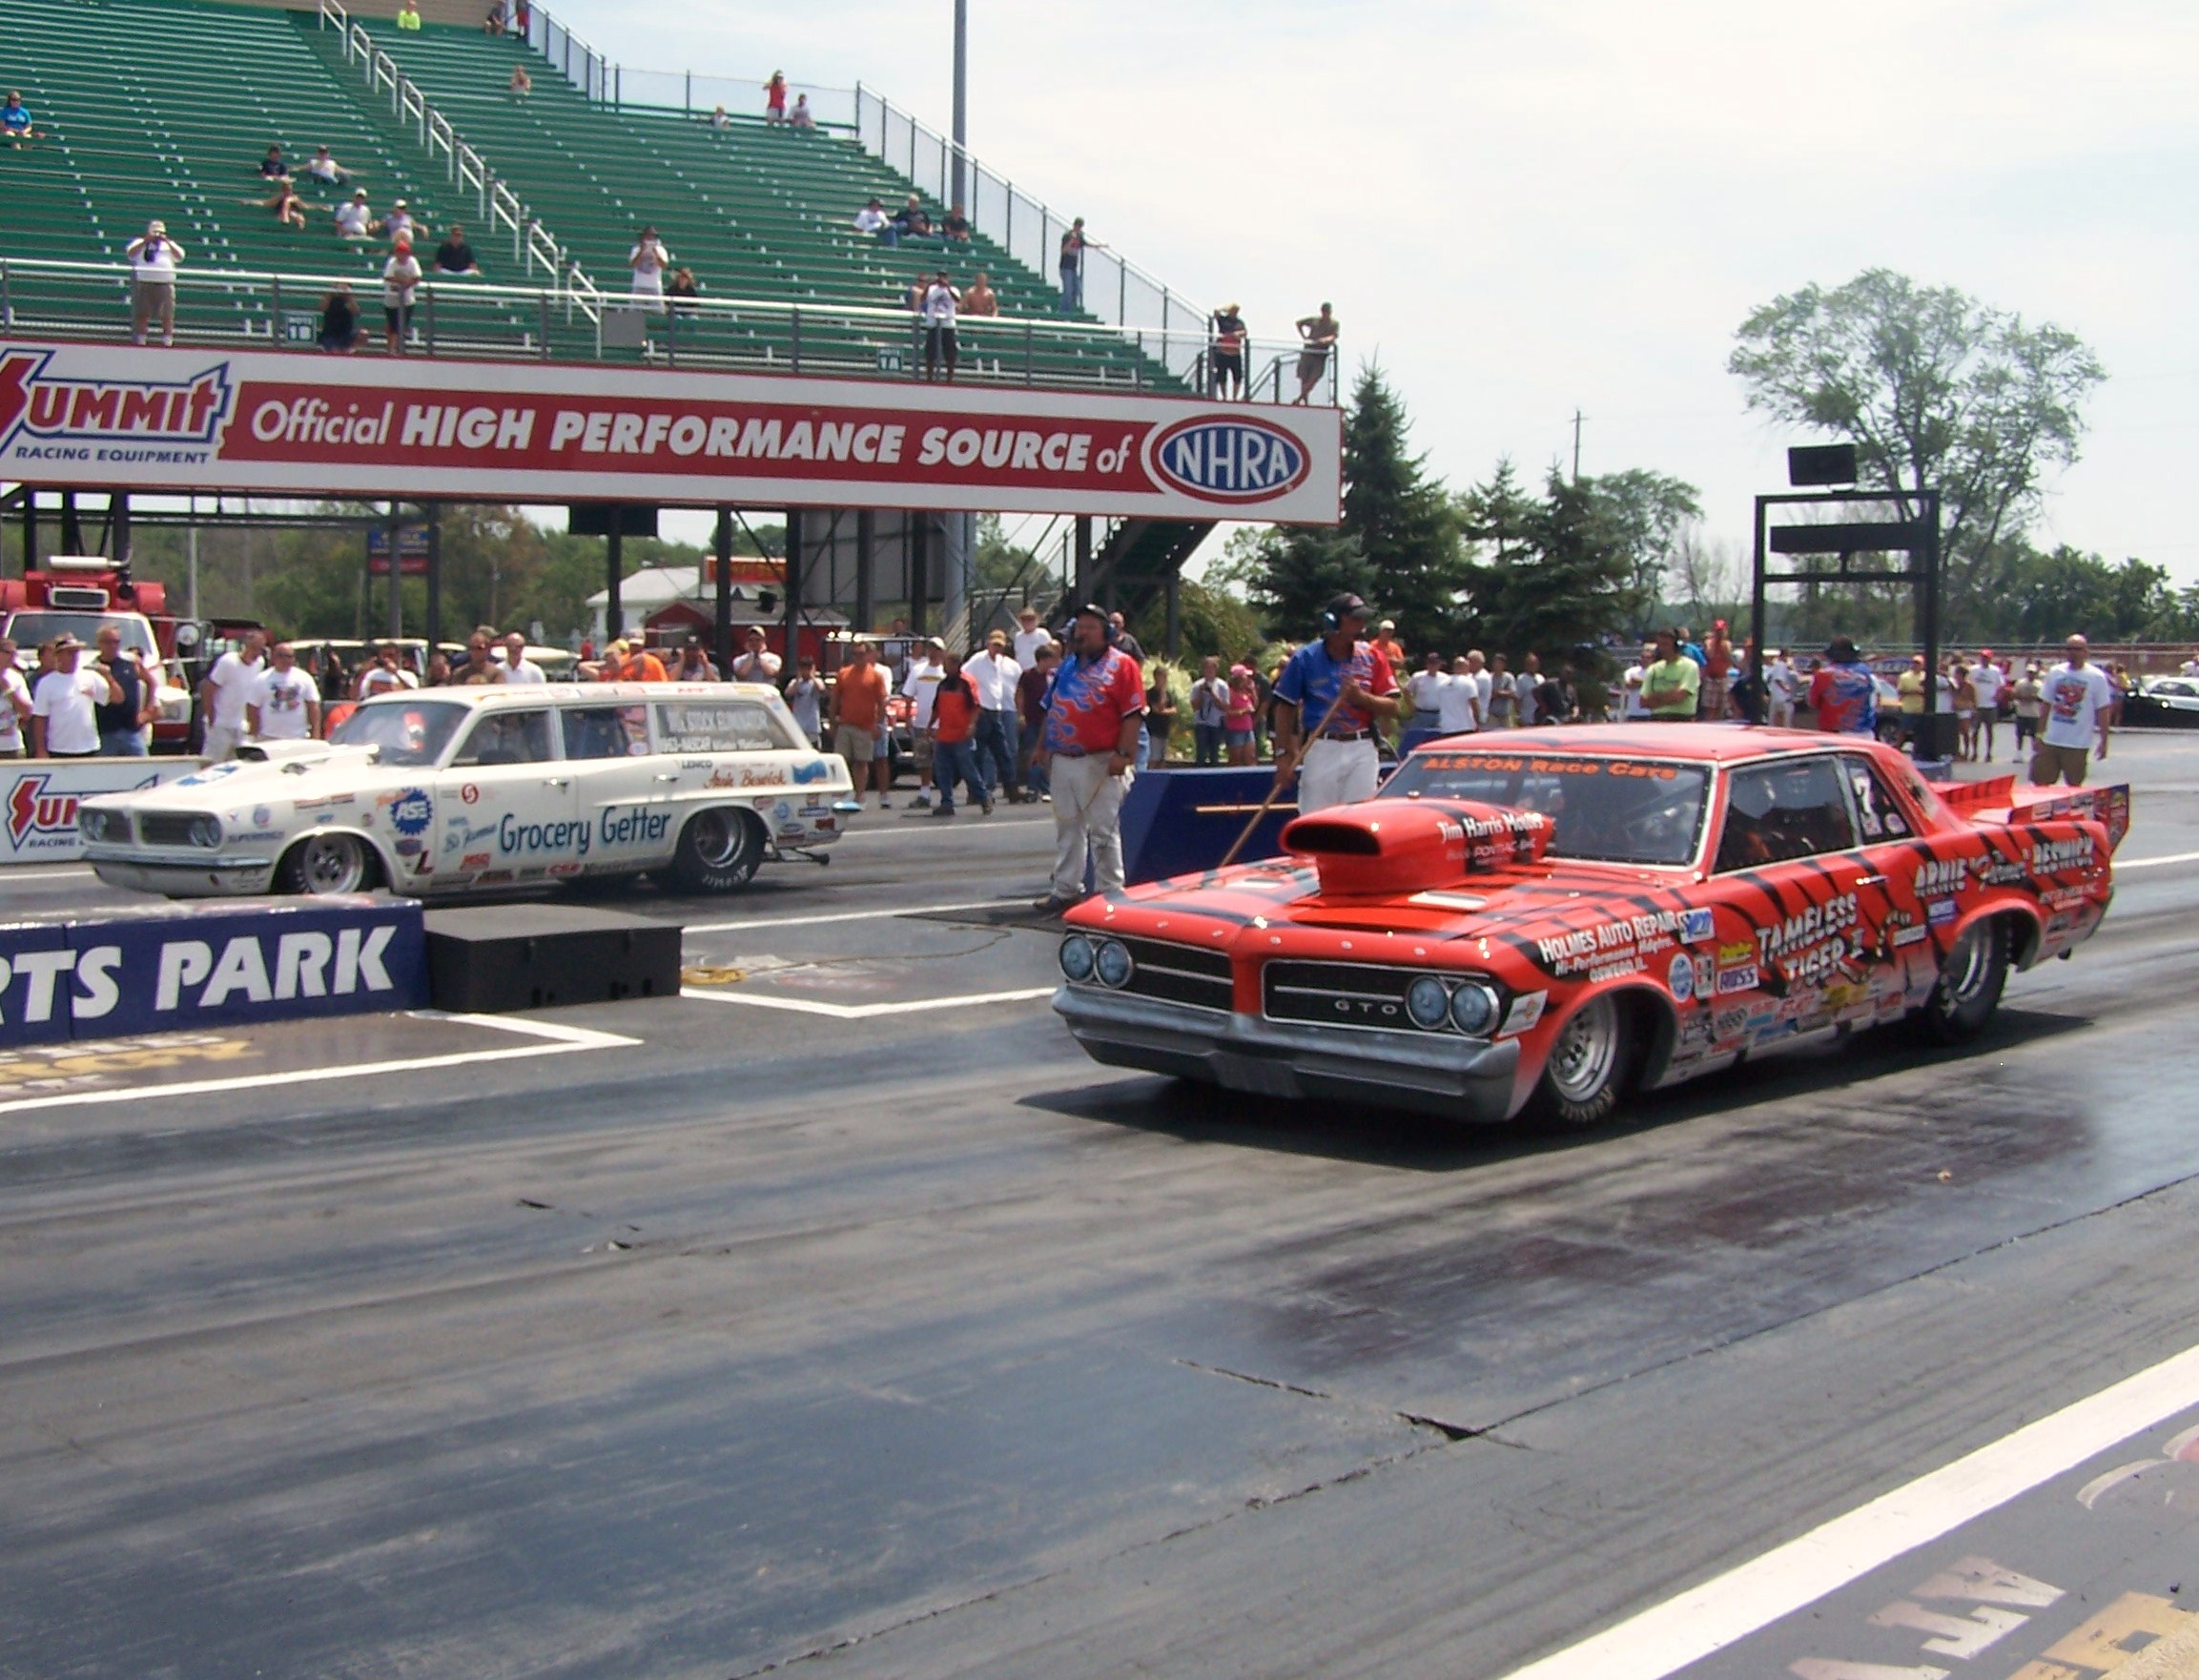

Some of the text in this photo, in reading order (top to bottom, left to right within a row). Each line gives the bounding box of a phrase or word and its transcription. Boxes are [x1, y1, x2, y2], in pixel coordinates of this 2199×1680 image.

[251, 400, 1134, 474] Official HIGH PERFORMANCE SOURCE of
[15, 445, 211, 465] RACING EQUIPMENT
[1174, 427, 1290, 490] NHRA
[1422, 756, 1524, 771] ALSTON
[395, 800, 430, 822] ASE
[29, 836, 76, 849] RACING
[500, 811, 592, 856] Grocery
[600, 806, 672, 847] Getter
[1436, 820, 1466, 845] Jim
[1462, 815, 1506, 838] Harris
[1537, 929, 1598, 964] HOLMES
[1596, 920, 1634, 950] AUTO
[0, 924, 399, 1026] TS PARK
[1333, 997, 1398, 1016] GTO
